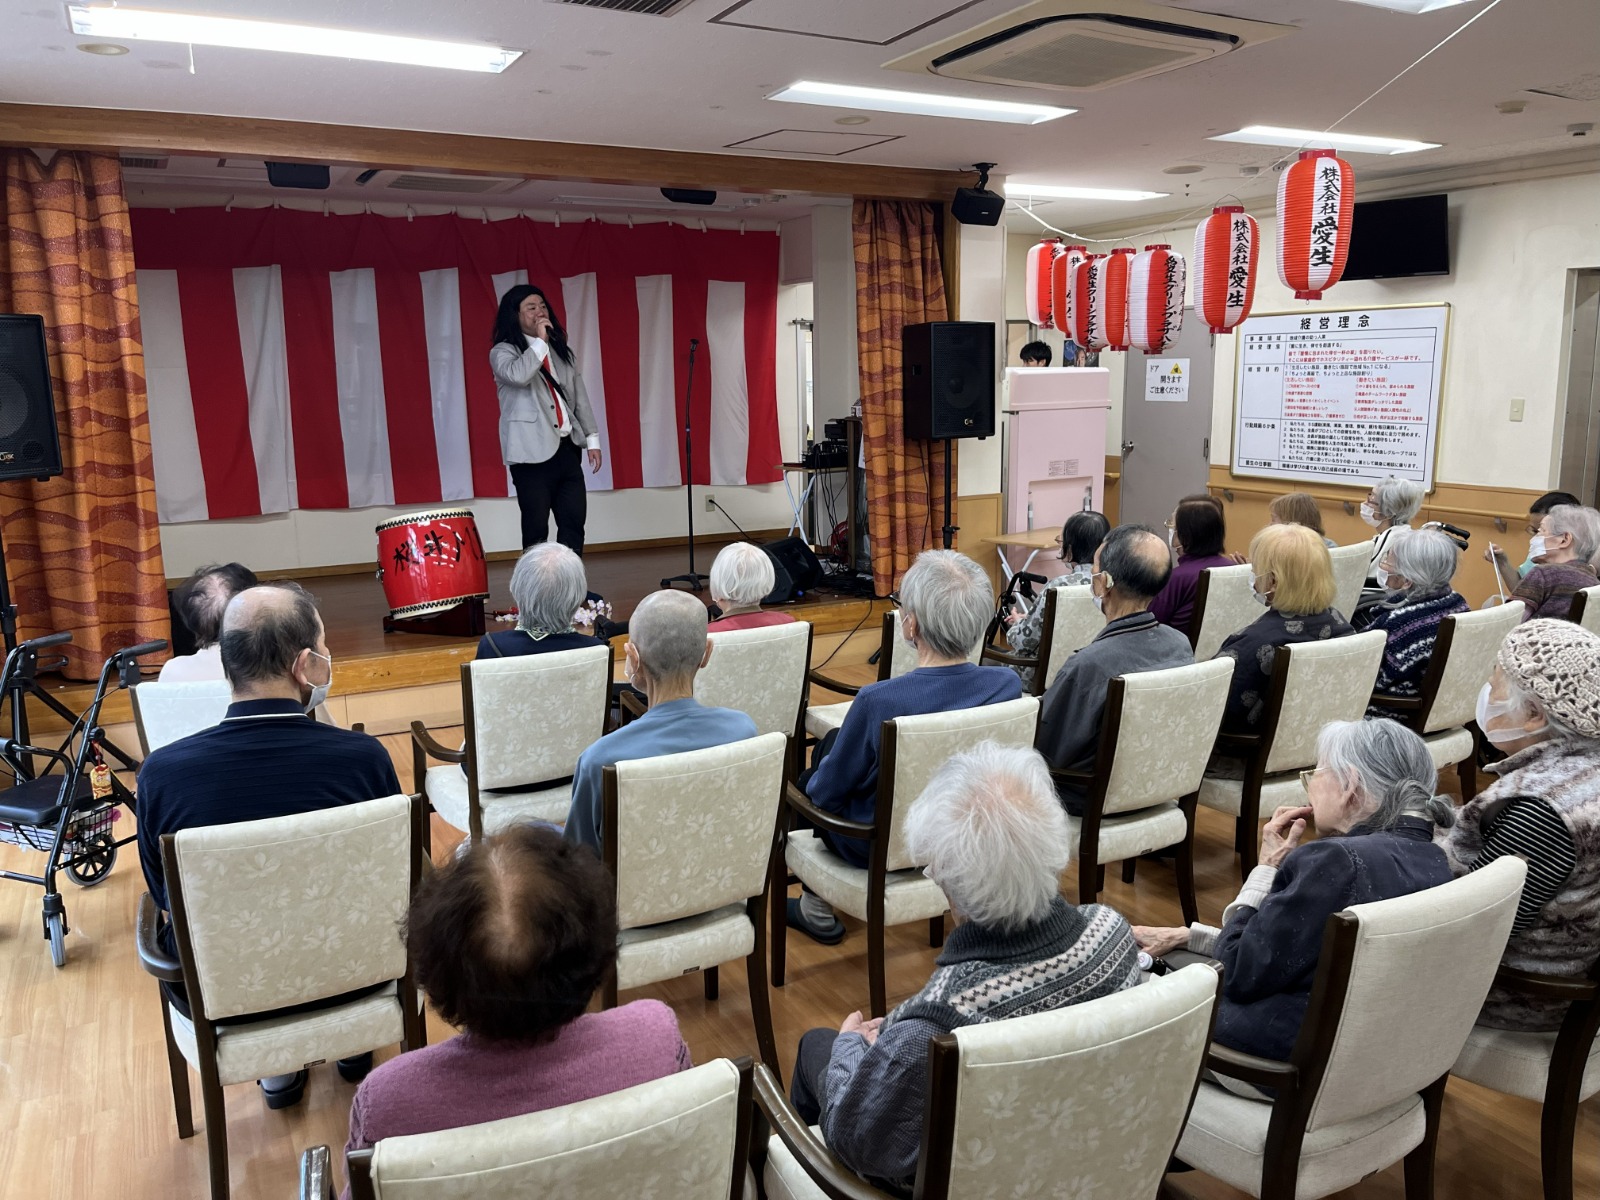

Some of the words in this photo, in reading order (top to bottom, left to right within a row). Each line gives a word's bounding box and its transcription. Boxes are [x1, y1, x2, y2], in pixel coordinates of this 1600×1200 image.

[1309, 166, 1340, 267] 株式会社愛生
[1226, 219, 1251, 308] 株式会社愛生
[1300, 315, 1371, 330] 経営理念
[1160, 375, 1182, 383] 開きます
[1149, 386, 1184, 394] ご注意ください
